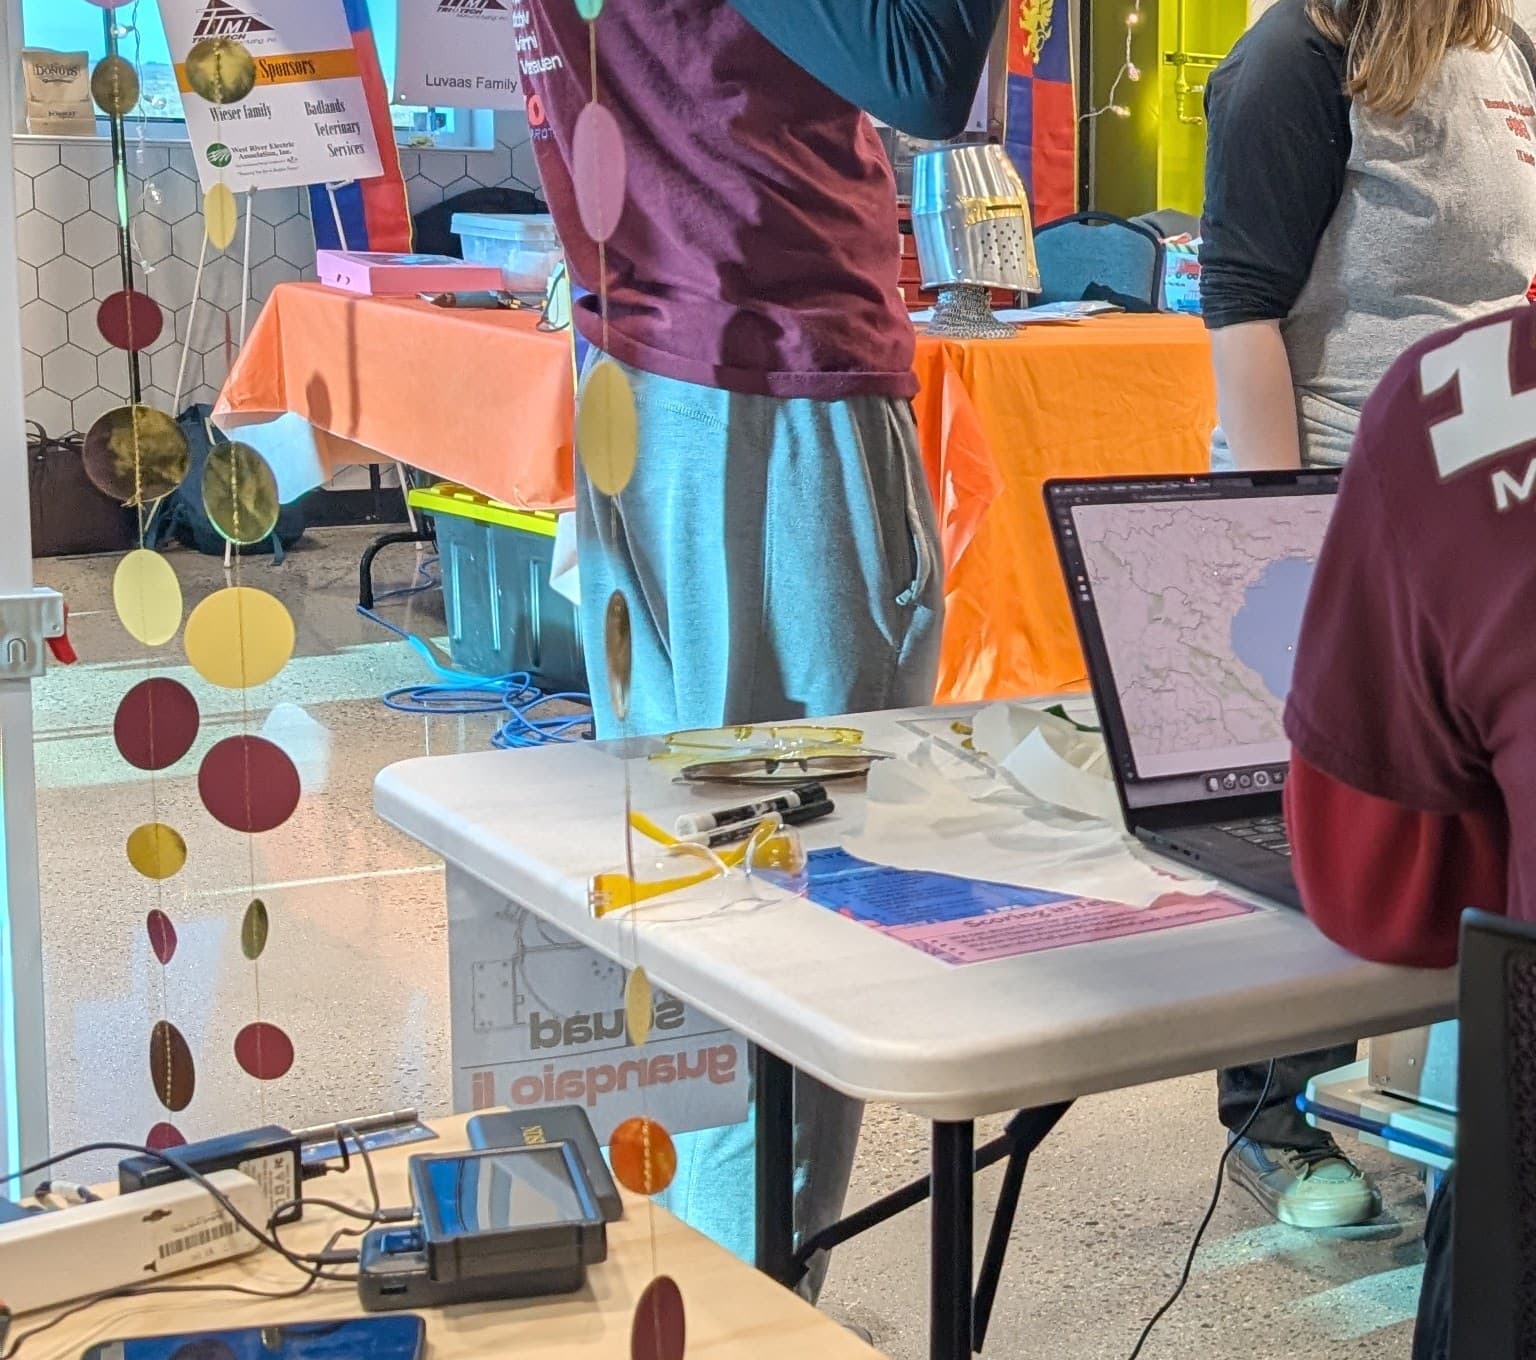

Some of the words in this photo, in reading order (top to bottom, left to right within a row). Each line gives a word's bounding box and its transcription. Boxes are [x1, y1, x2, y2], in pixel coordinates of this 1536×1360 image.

[259, 60, 316, 83] Sponsors
[425, 74, 471, 89] Luvaas
[476, 76, 518, 94] Family
[304, 98, 347, 116] Badlands
[314, 120, 362, 137] Veterinary
[327, 140, 366, 158] Services
